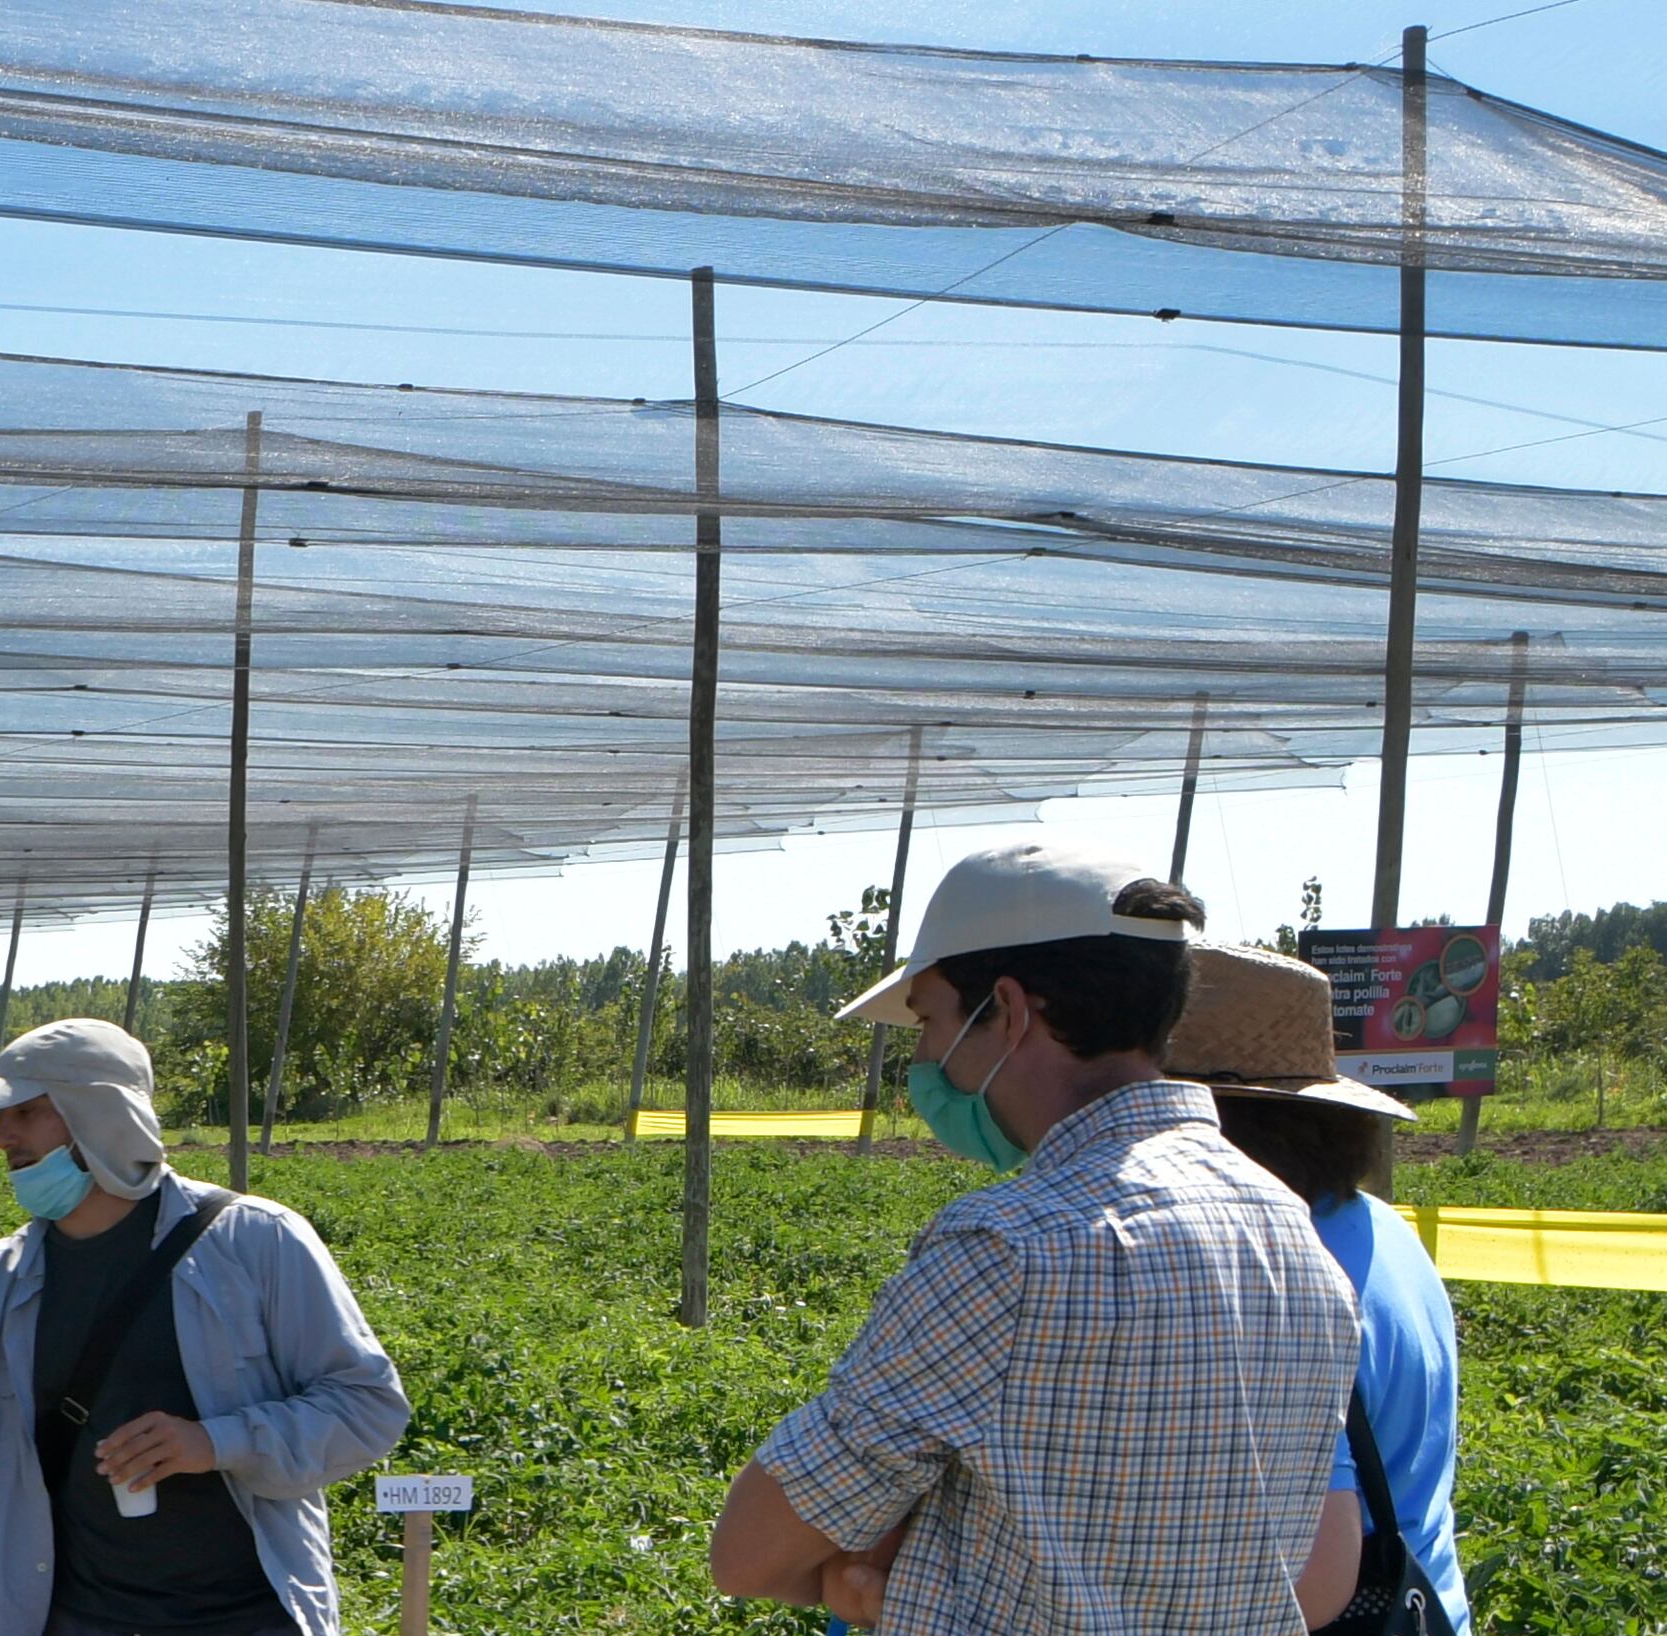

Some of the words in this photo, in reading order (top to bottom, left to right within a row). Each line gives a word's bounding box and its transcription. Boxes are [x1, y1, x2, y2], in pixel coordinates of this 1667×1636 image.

[1370, 969, 1403, 981] Forte
[1353, 985, 1390, 1003] polilla
[1333, 1004, 1375, 1016] tomate
[1372, 1062, 1417, 1075] Proclaim
[1418, 1061, 1444, 1073] Forte
[390, 1487, 418, 1505] HM
[424, 1486, 462, 1505] 1892
